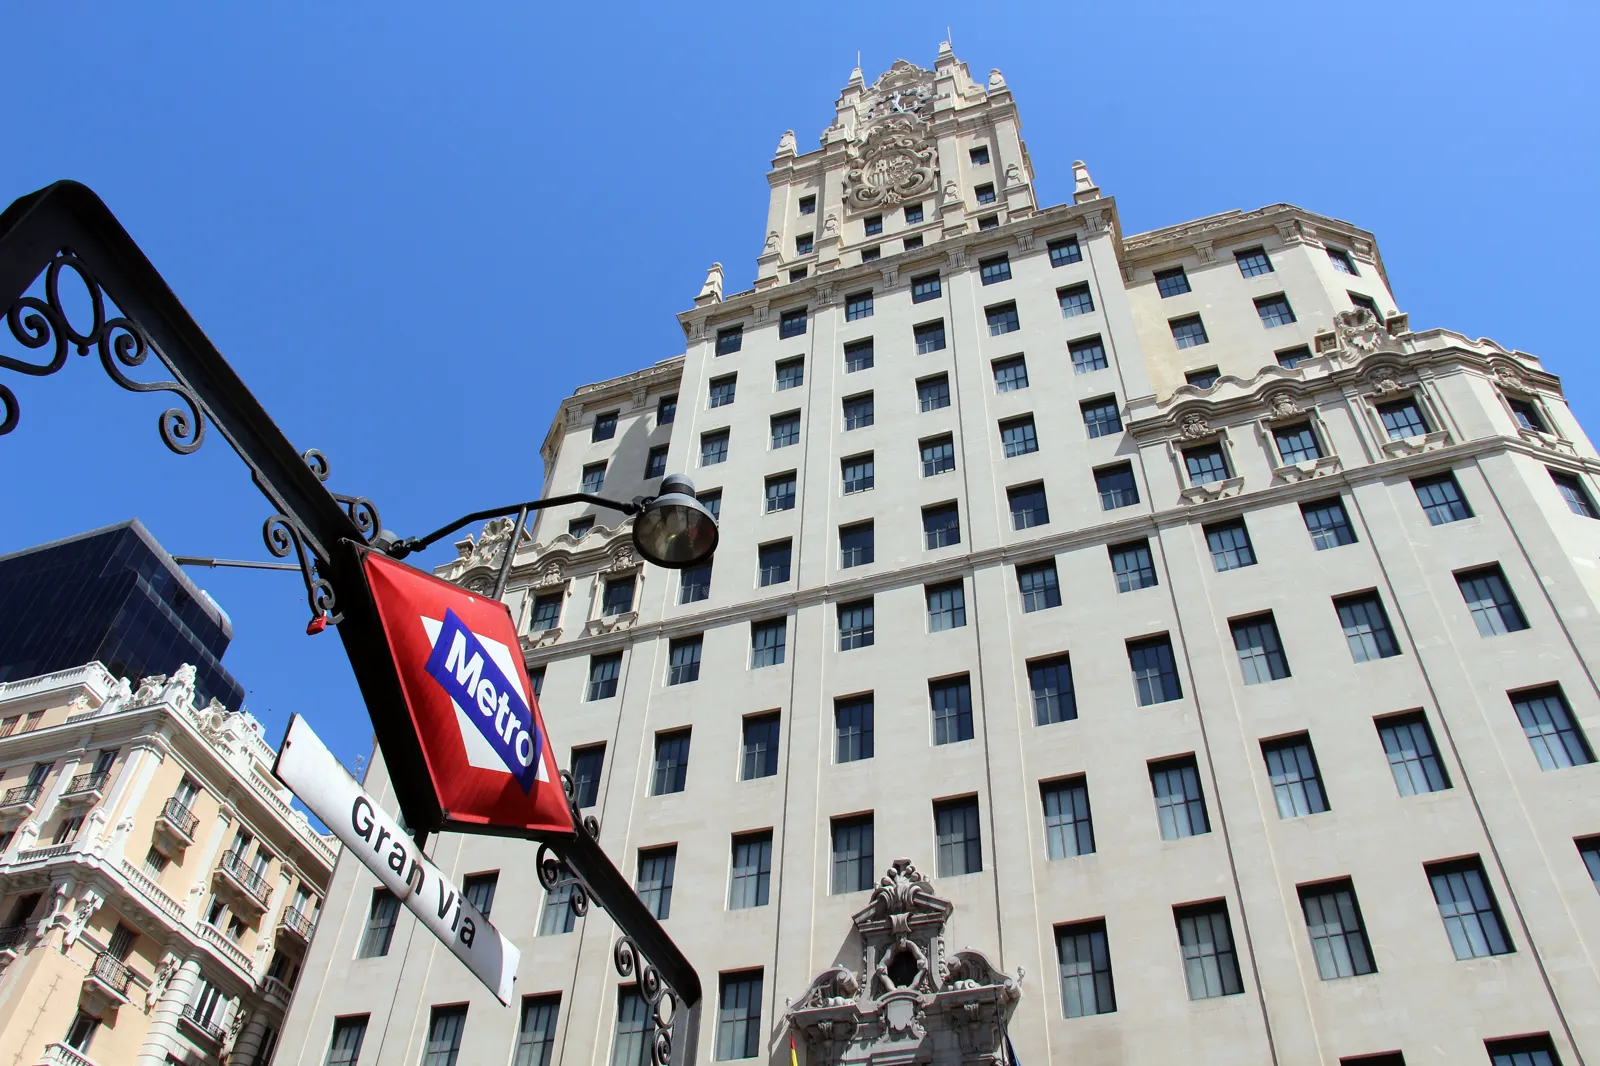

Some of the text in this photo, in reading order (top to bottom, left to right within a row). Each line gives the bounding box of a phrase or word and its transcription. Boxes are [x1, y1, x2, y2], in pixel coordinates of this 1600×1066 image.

[445, 629, 533, 767] Metro
[352, 796, 475, 949] Gran Via
